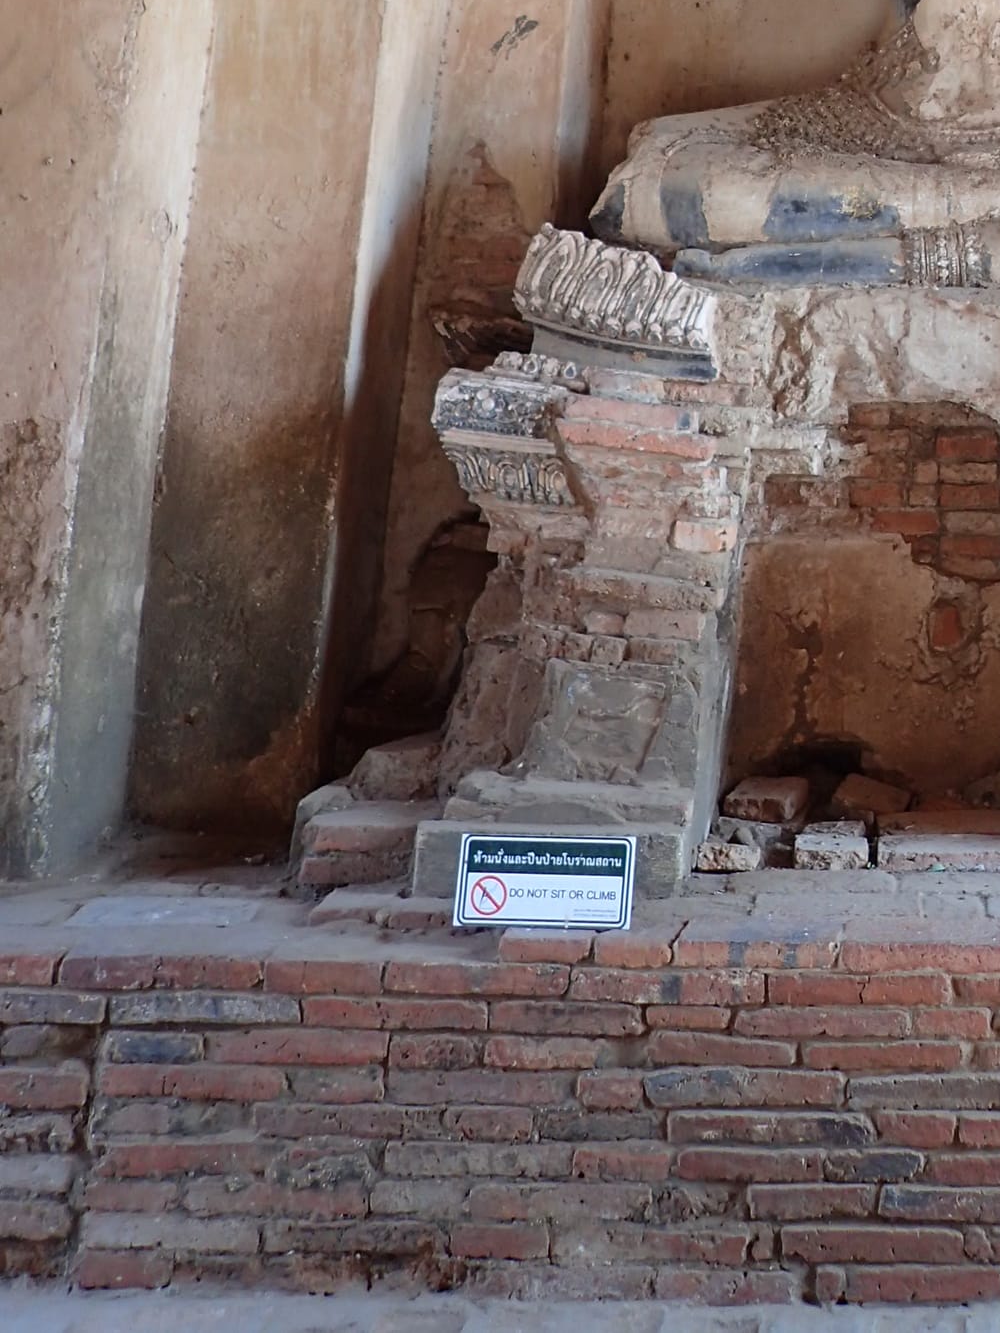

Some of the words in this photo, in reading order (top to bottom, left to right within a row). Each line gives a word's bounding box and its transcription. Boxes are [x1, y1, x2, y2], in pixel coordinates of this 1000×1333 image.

[509, 888, 524, 898] DO
[527, 888, 548, 899] NOT
[550, 889, 566, 899] SIT
[568, 890, 584, 900] OR
[586, 890, 617, 901] CLIMB
